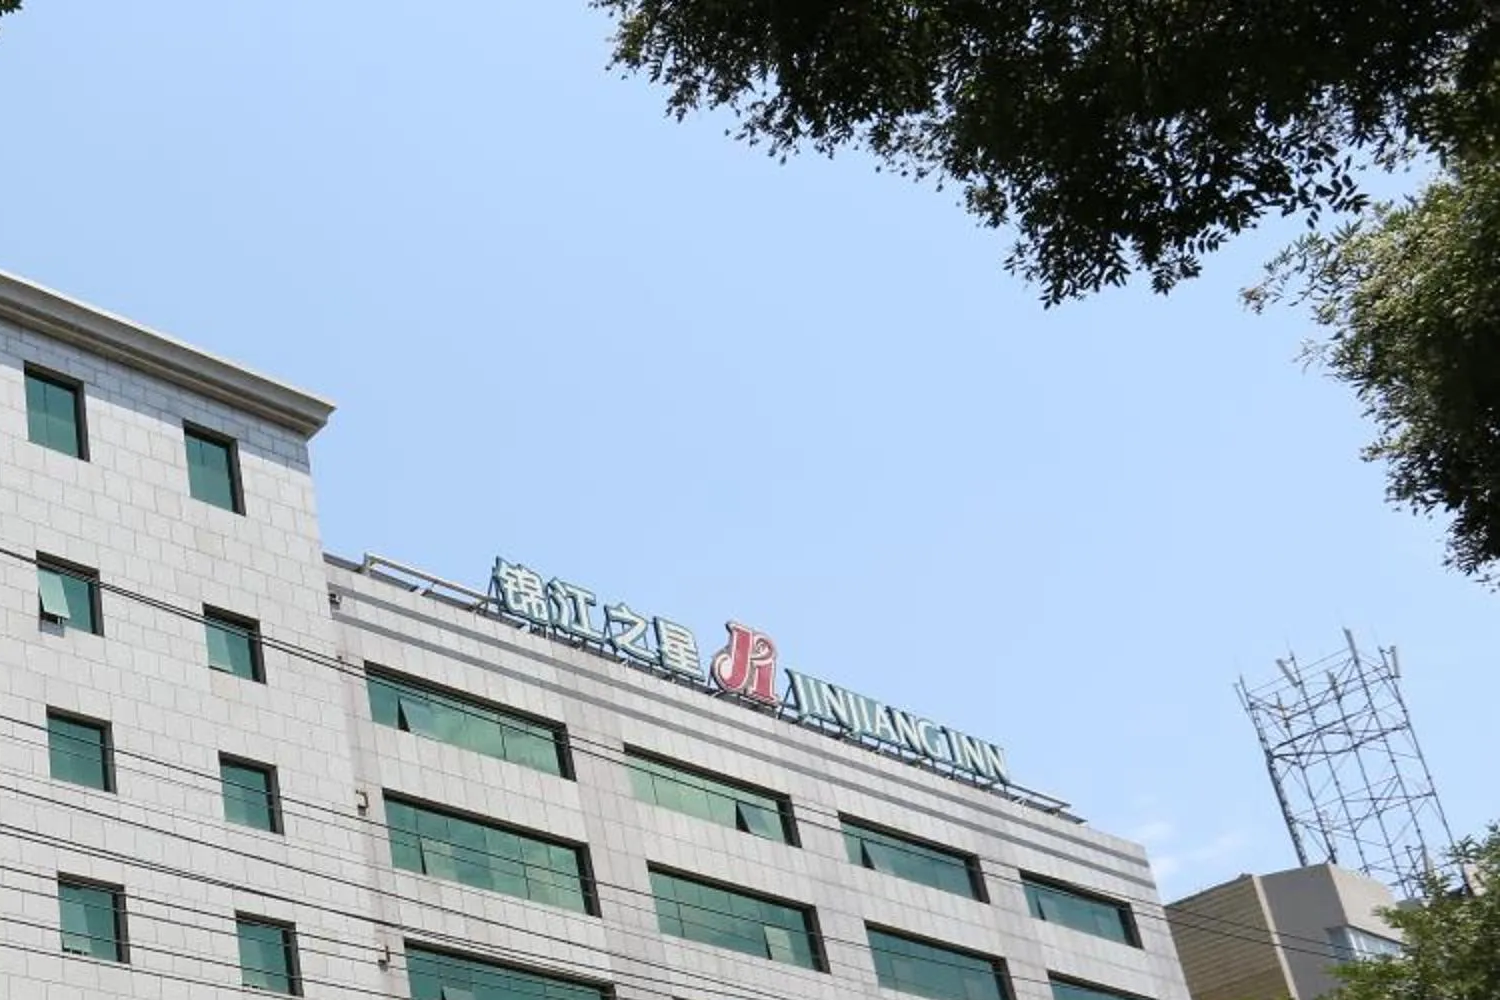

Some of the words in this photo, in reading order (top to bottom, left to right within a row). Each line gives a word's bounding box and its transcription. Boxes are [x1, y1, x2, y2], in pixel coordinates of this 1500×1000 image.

[496, 558, 703, 682] 锦江之星
[788, 670, 944, 760] JINJIANG
[942, 726, 1009, 785] INN
